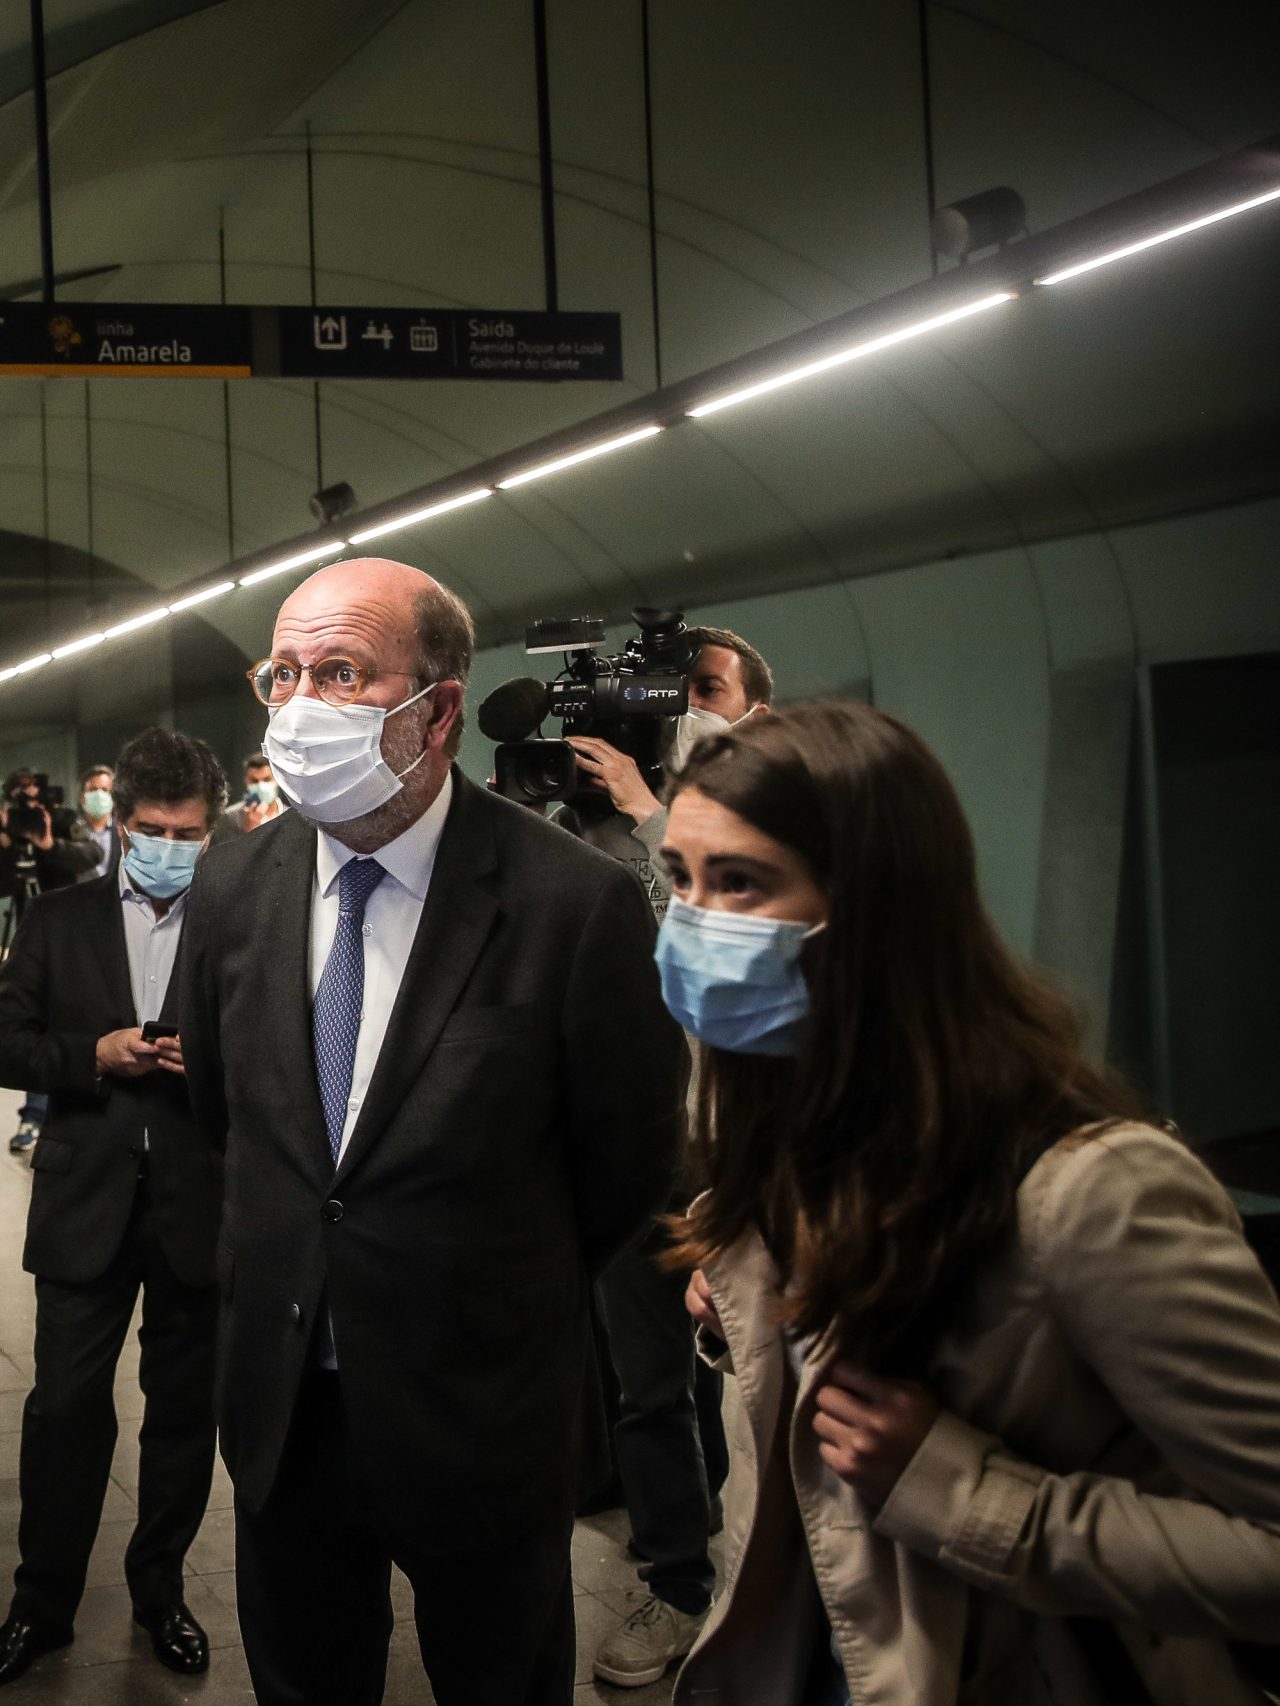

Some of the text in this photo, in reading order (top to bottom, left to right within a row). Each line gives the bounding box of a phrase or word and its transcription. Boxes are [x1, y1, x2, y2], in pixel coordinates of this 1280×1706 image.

[97, 321, 135, 336] linha
[99, 339, 192, 362] Amarela
[647, 689, 679, 698] RTP
